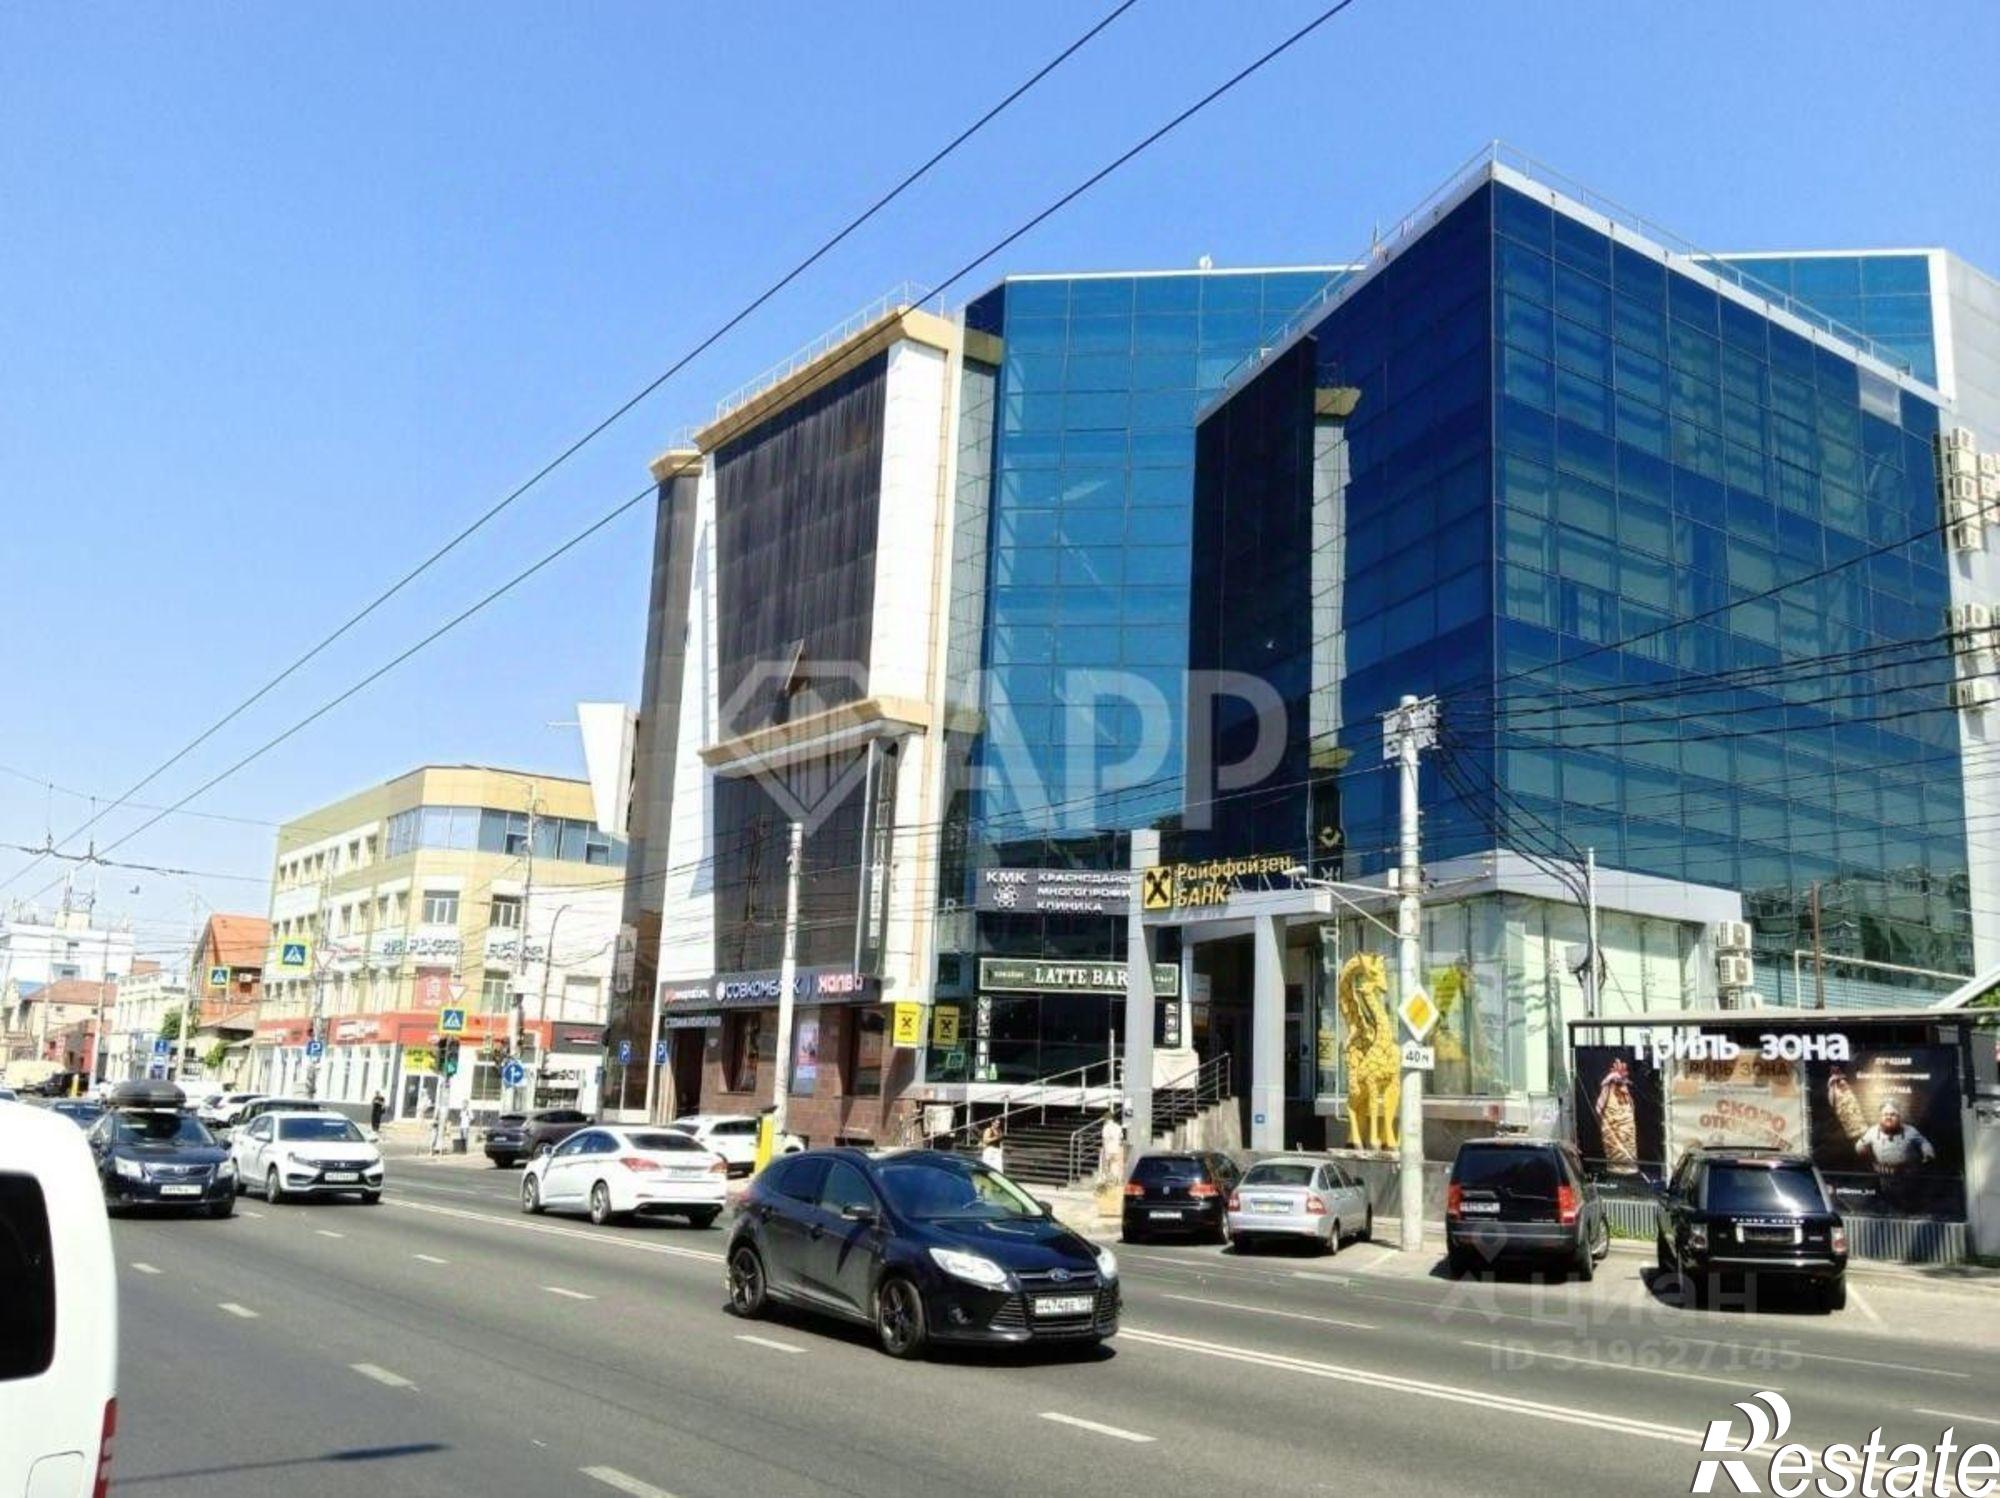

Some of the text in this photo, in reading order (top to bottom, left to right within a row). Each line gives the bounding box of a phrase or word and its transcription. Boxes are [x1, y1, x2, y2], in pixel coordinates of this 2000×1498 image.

[986, 871, 1027, 883] КМК
[1176, 854, 1291, 881] Райффайзен
[1037, 900, 1102, 910] КЛИНИКА
[1176, 883, 1229, 907] БАНК
[1035, 967, 1086, 985] LATTE
[1092, 969, 1129, 986] BAR
[726, 977, 801, 999] СОВКОМБК
[1406, 1049, 1420, 1063] 40
[1760, 1033, 1850, 1061] зона
